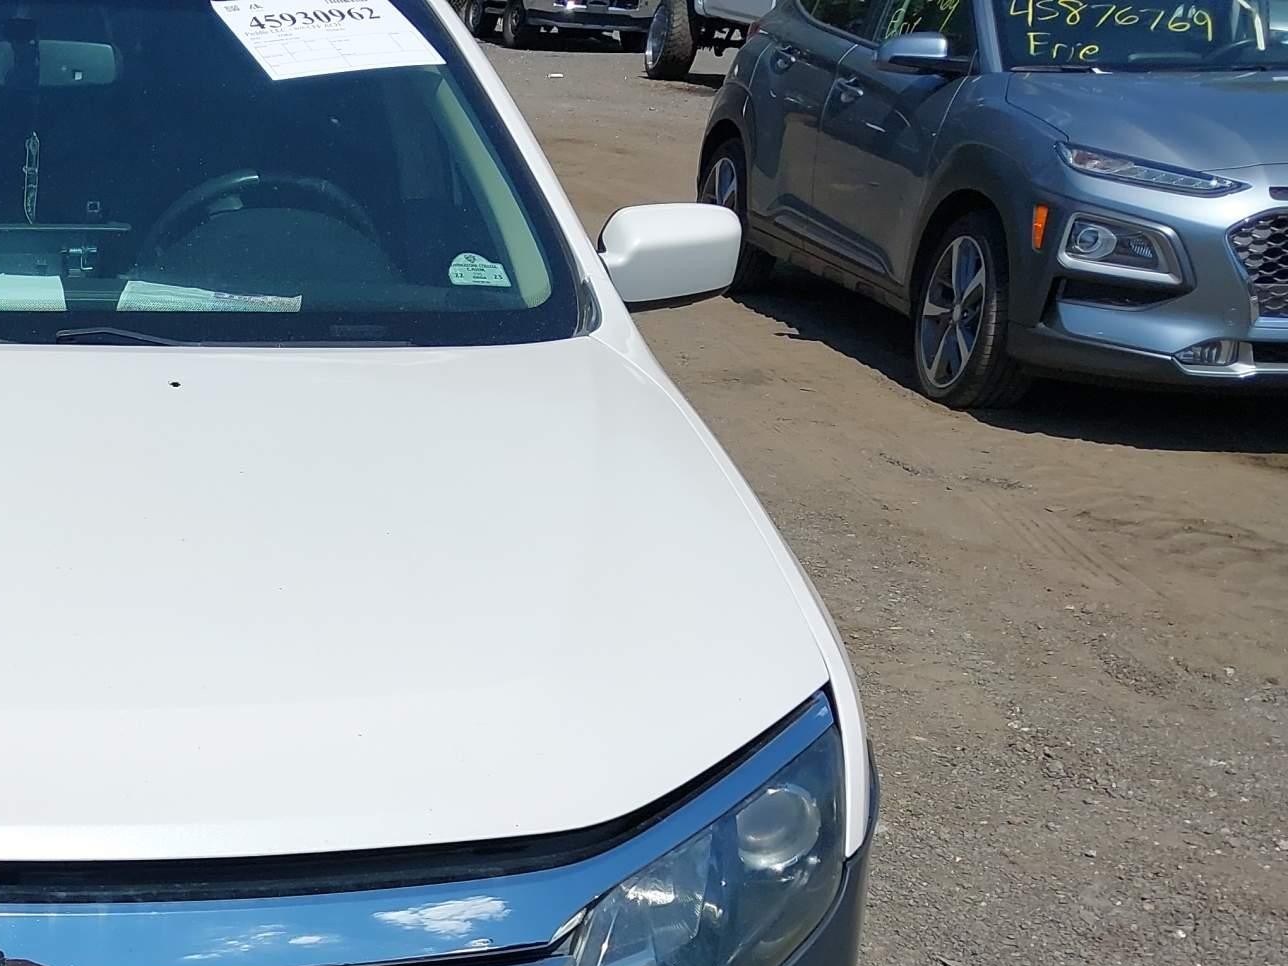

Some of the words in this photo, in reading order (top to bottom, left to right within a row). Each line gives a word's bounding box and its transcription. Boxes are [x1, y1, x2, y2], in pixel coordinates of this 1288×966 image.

[248, 6, 382, 31] 45930962
[1010, 0, 1212, 42] 45876769
[1026, 32, 1100, 62] Erie
